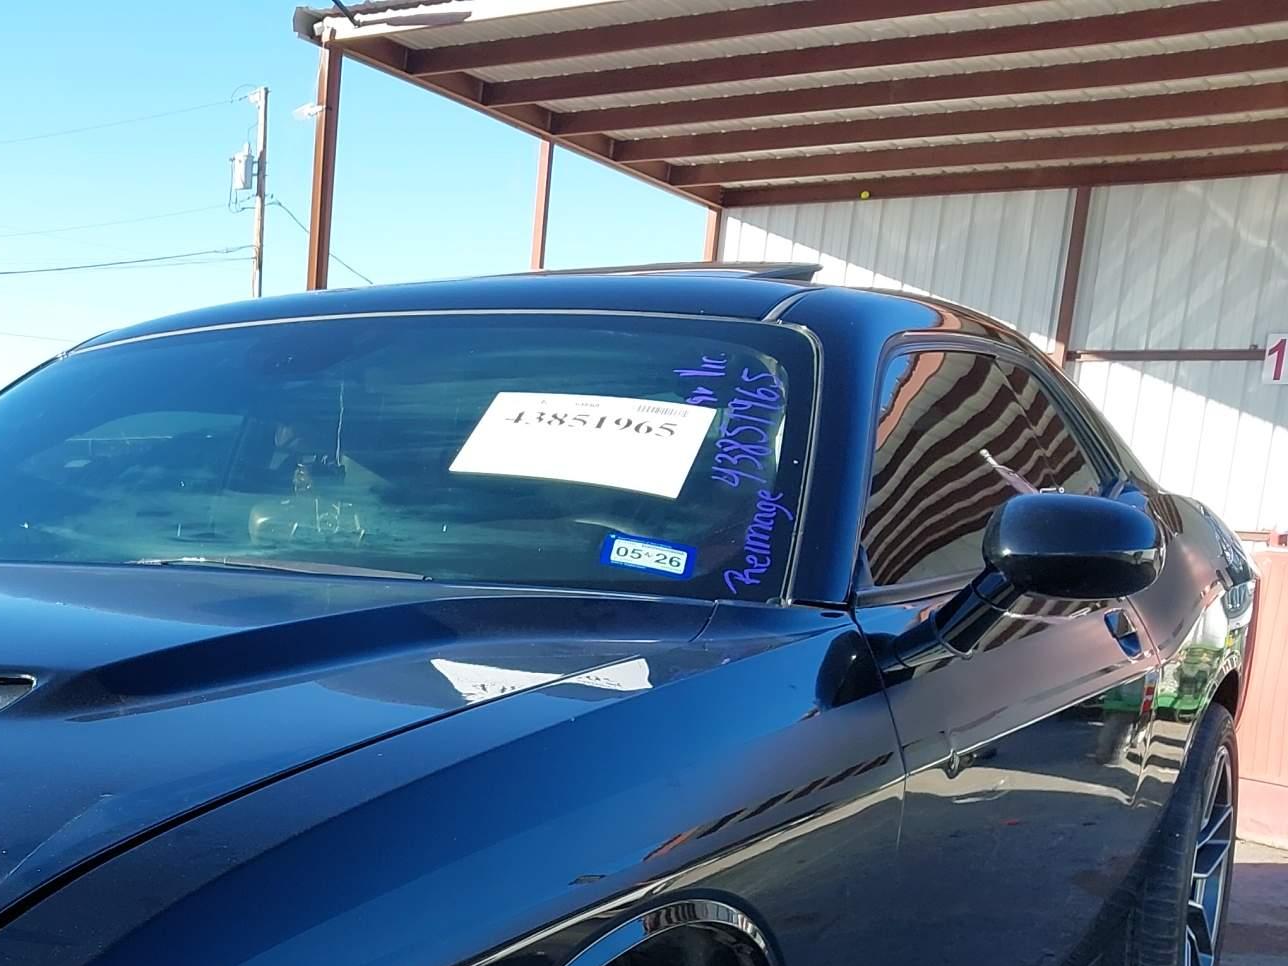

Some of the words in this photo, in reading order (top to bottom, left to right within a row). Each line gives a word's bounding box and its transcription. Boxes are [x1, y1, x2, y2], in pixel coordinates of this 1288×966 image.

[506, 411, 678, 437] 43851965
[711, 367, 781, 487] 43851965
[616, 546, 642, 560] 05
[655, 553, 682, 568] 26
[723, 489, 793, 594] Reimage
